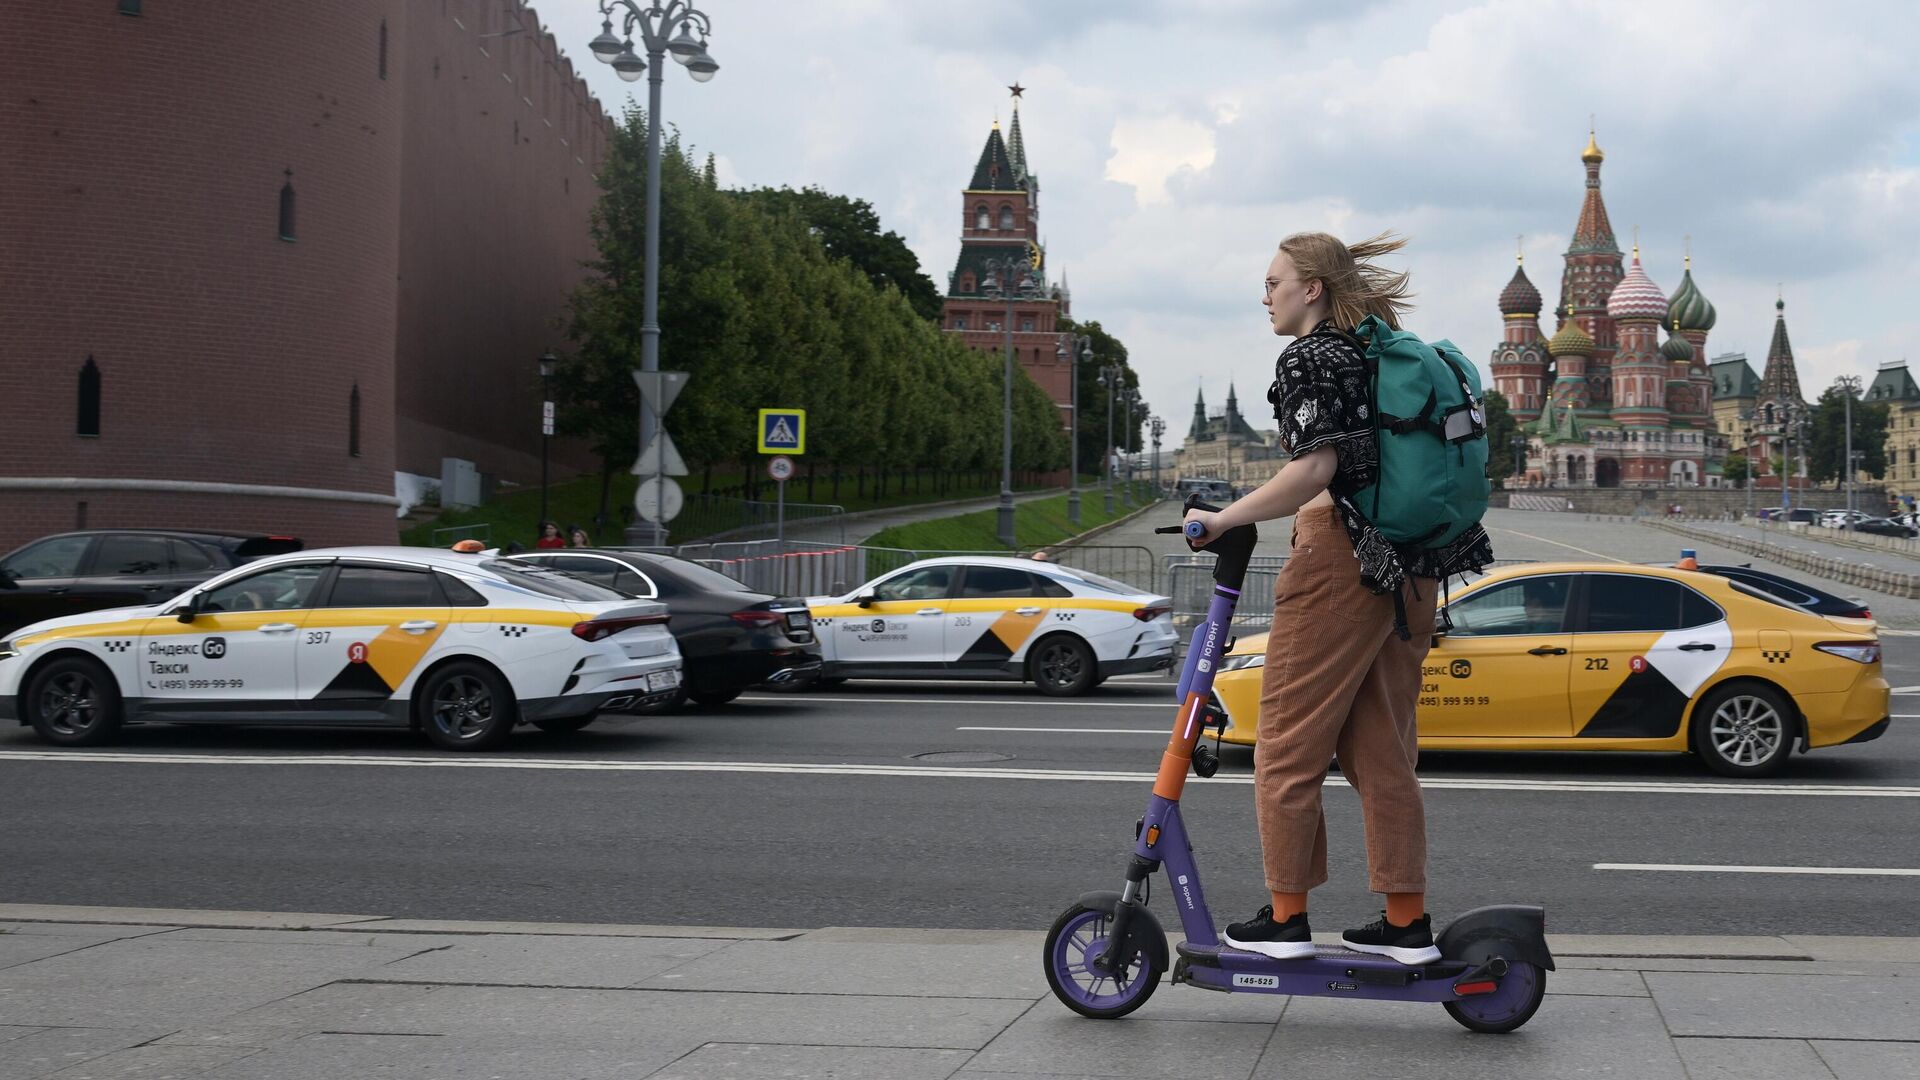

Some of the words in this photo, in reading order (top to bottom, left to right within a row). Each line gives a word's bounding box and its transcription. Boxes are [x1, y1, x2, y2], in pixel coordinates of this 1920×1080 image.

[954, 616, 972, 627] 203
[306, 631, 331, 645] 397
[1203, 621, 1219, 657] юрент
[148, 641, 199, 656] Яндекс
[204, 640, 225, 656] Go
[352, 645, 364, 660] Я
[148, 660, 190, 674] Такси
[1421, 666, 1448, 676] декс
[1452, 662, 1471, 676] Go
[1585, 657, 1609, 671] 212
[160, 680, 187, 690] (495)
[188, 679, 244, 689] 999-99-99
[1421, 683, 1439, 693] кси
[1442, 697, 1460, 706] 999
[1463, 696, 1475, 706] 99
[1478, 696, 1490, 705] 99
[1182, 885, 1194, 909] юрент
[1239, 976, 1274, 986] 145-525
